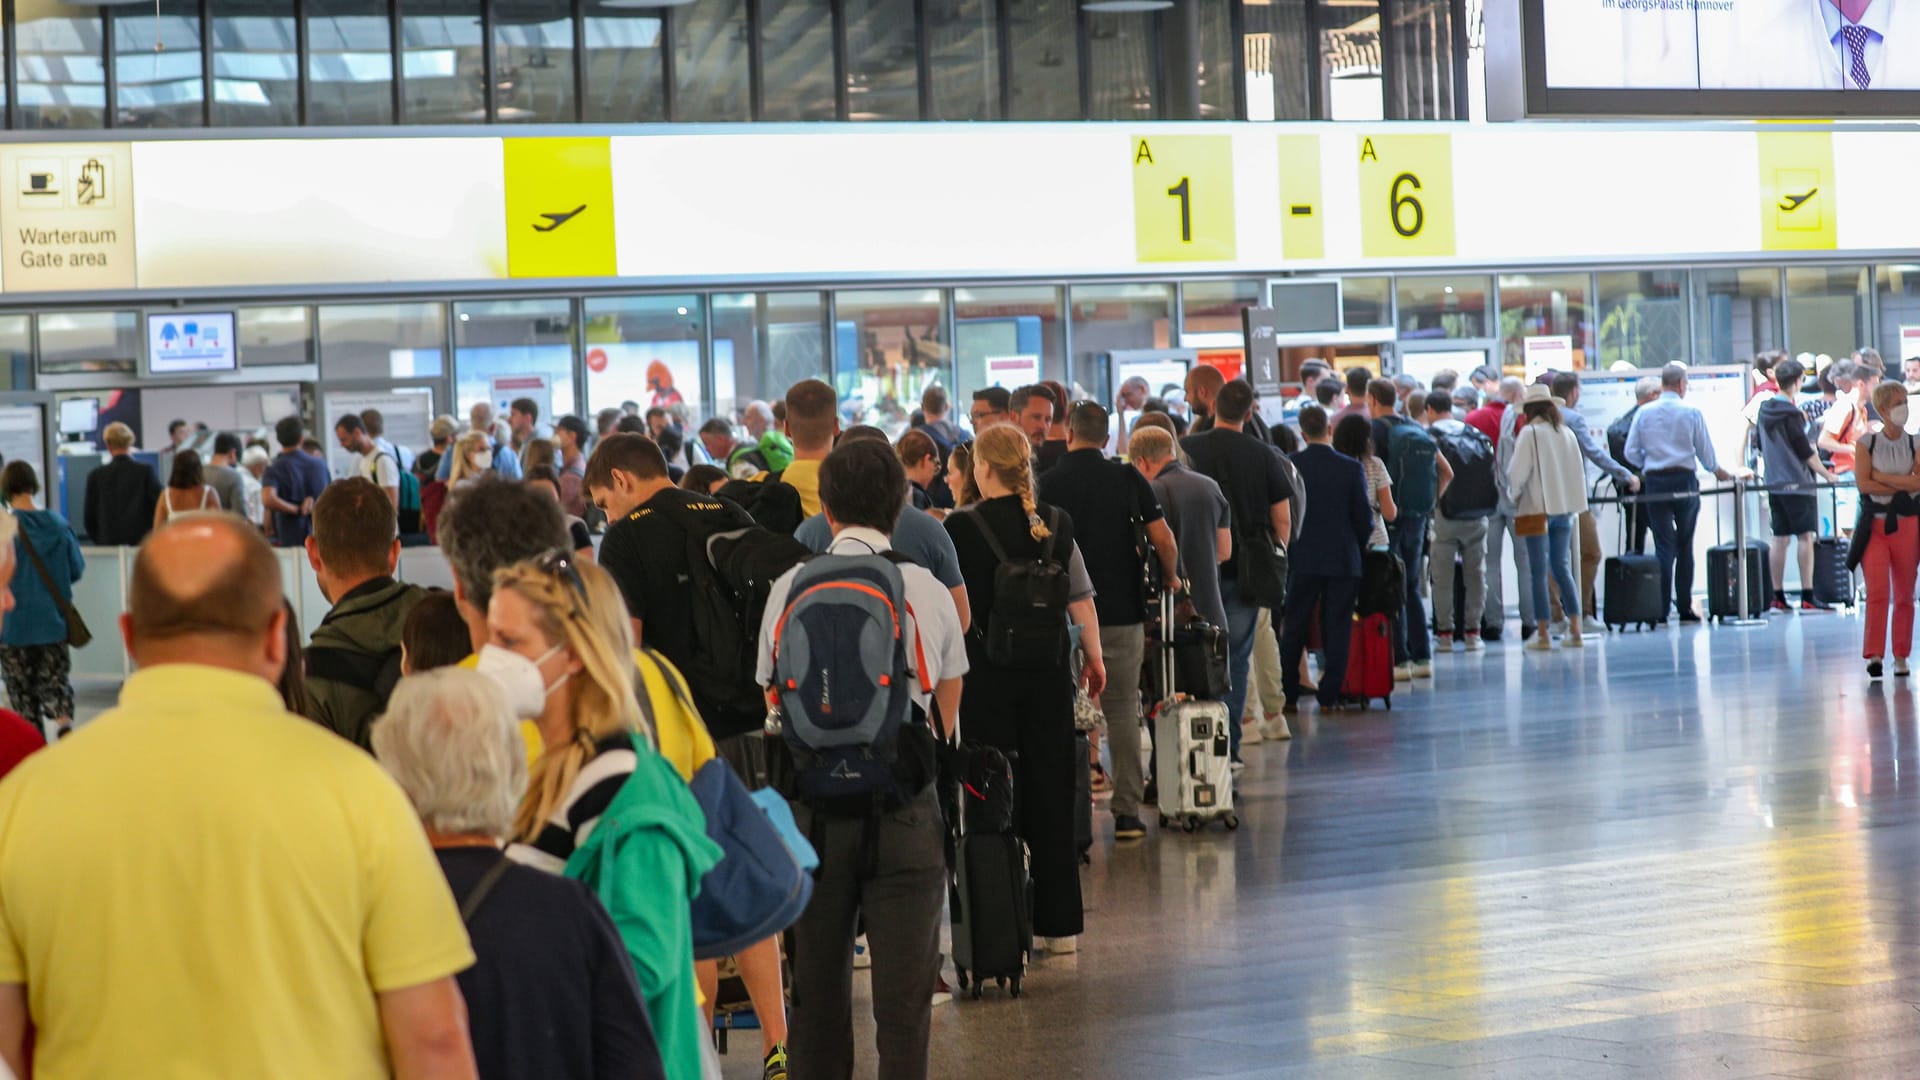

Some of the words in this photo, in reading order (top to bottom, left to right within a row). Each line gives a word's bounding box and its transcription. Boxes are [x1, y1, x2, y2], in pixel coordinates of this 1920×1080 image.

[1686, 0, 1734, 11] Hannover
[1136, 139, 1153, 163] A
[1361, 137, 1377, 161] A
[1168, 177, 1190, 241] 1
[1390, 172, 1423, 237] 6
[19, 228, 117, 245] Warteraum
[20, 249, 63, 268] Gate
[69, 251, 107, 267] area
